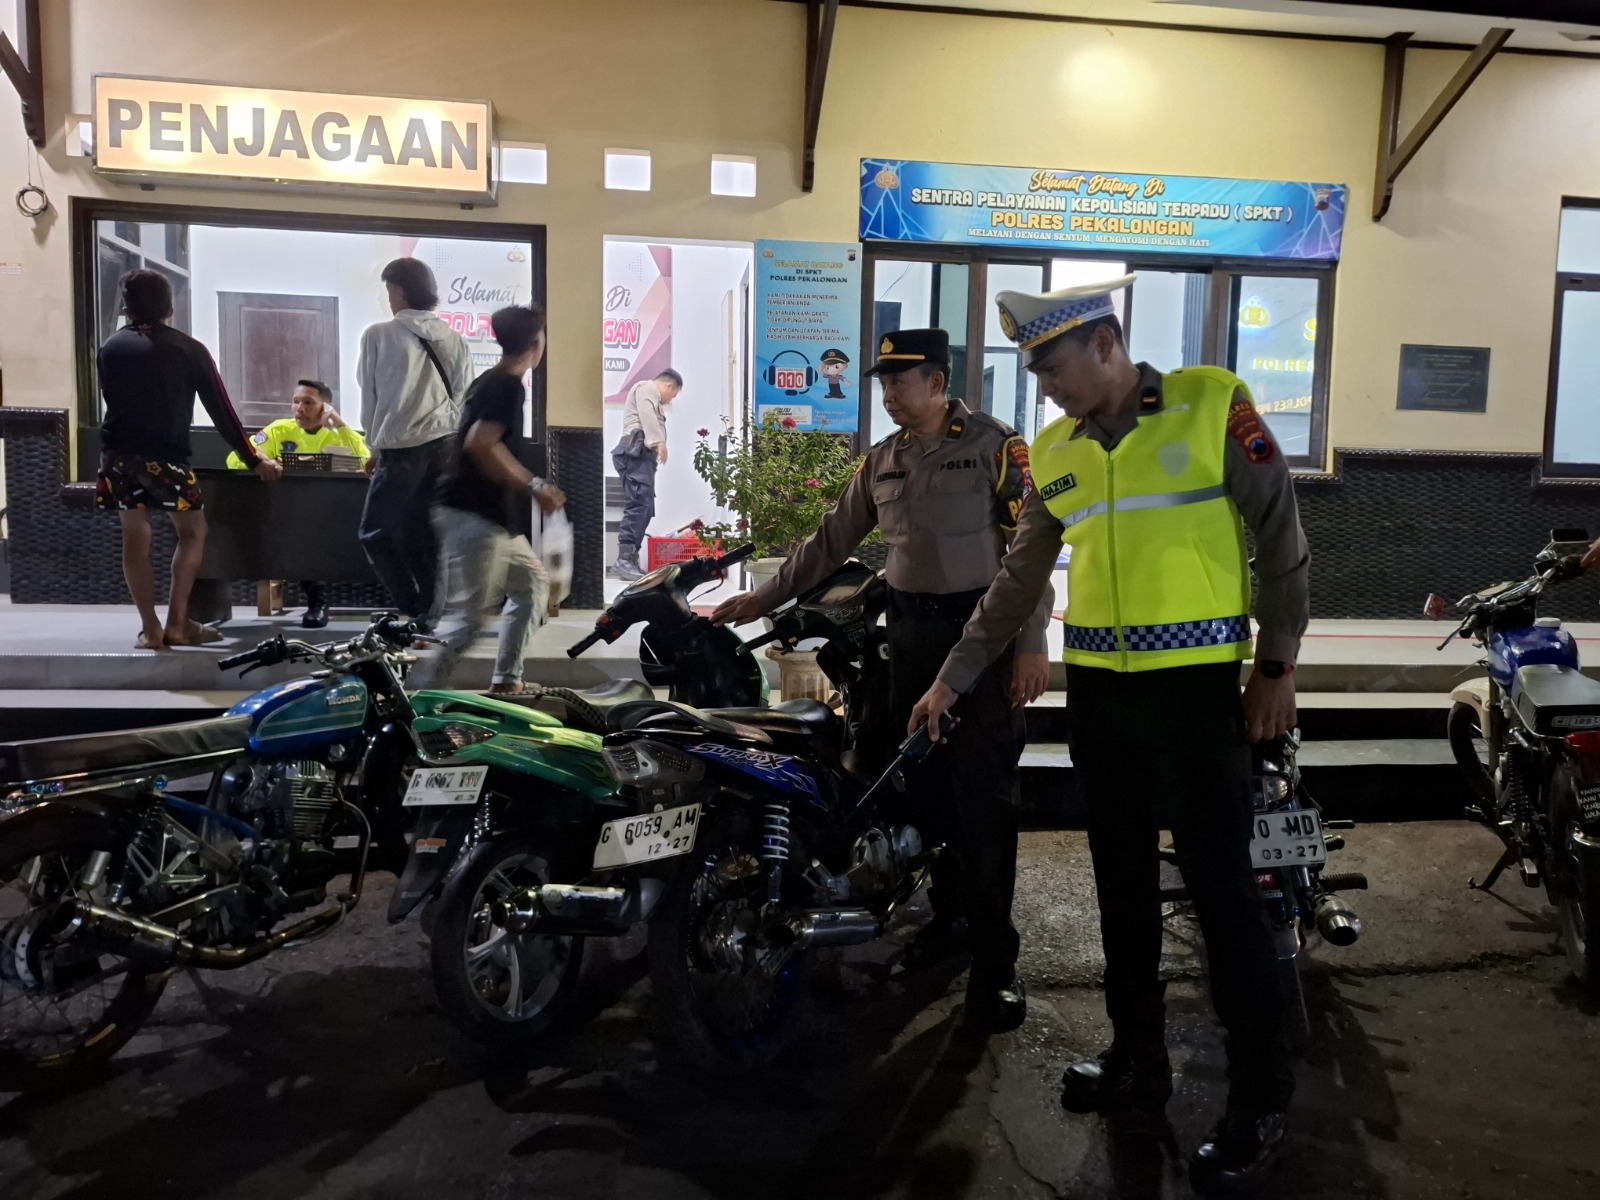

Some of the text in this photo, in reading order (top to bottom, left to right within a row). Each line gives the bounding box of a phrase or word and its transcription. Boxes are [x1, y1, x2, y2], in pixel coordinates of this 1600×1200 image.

[107, 98, 478, 171] PENJAGAAN
[1028, 169, 1166, 198] Selamat Datang Di
[911, 188, 973, 206] SENTRA
[977, 192, 1066, 212] PELAYANAN
[1070, 197, 1158, 216] KEPOLISIAN
[1162, 202, 1230, 219] TERPADU
[1243, 205, 1284, 221] SPKT
[991, 212, 1195, 236] POLRES PEKALONGAN
[968, 228, 1013, 239] MELAYANI
[1015, 230, 1051, 240] DENGAN
[1095, 234, 1150, 245] MENGAYOMI
[1151, 237, 1187, 246] DENGAN
[1189, 238, 1210, 247] HATI
[447, 276, 522, 306] Selamat
[605, 285, 632, 312] Di
[605, 359, 625, 370] KAMI
[778, 374, 803, 387] 110
[940, 459, 977, 472] POLRI
[1043, 476, 1072, 499] HAZIM
[601, 808, 697, 844] G 6059 AM
[1284, 814, 1315, 836] MD
